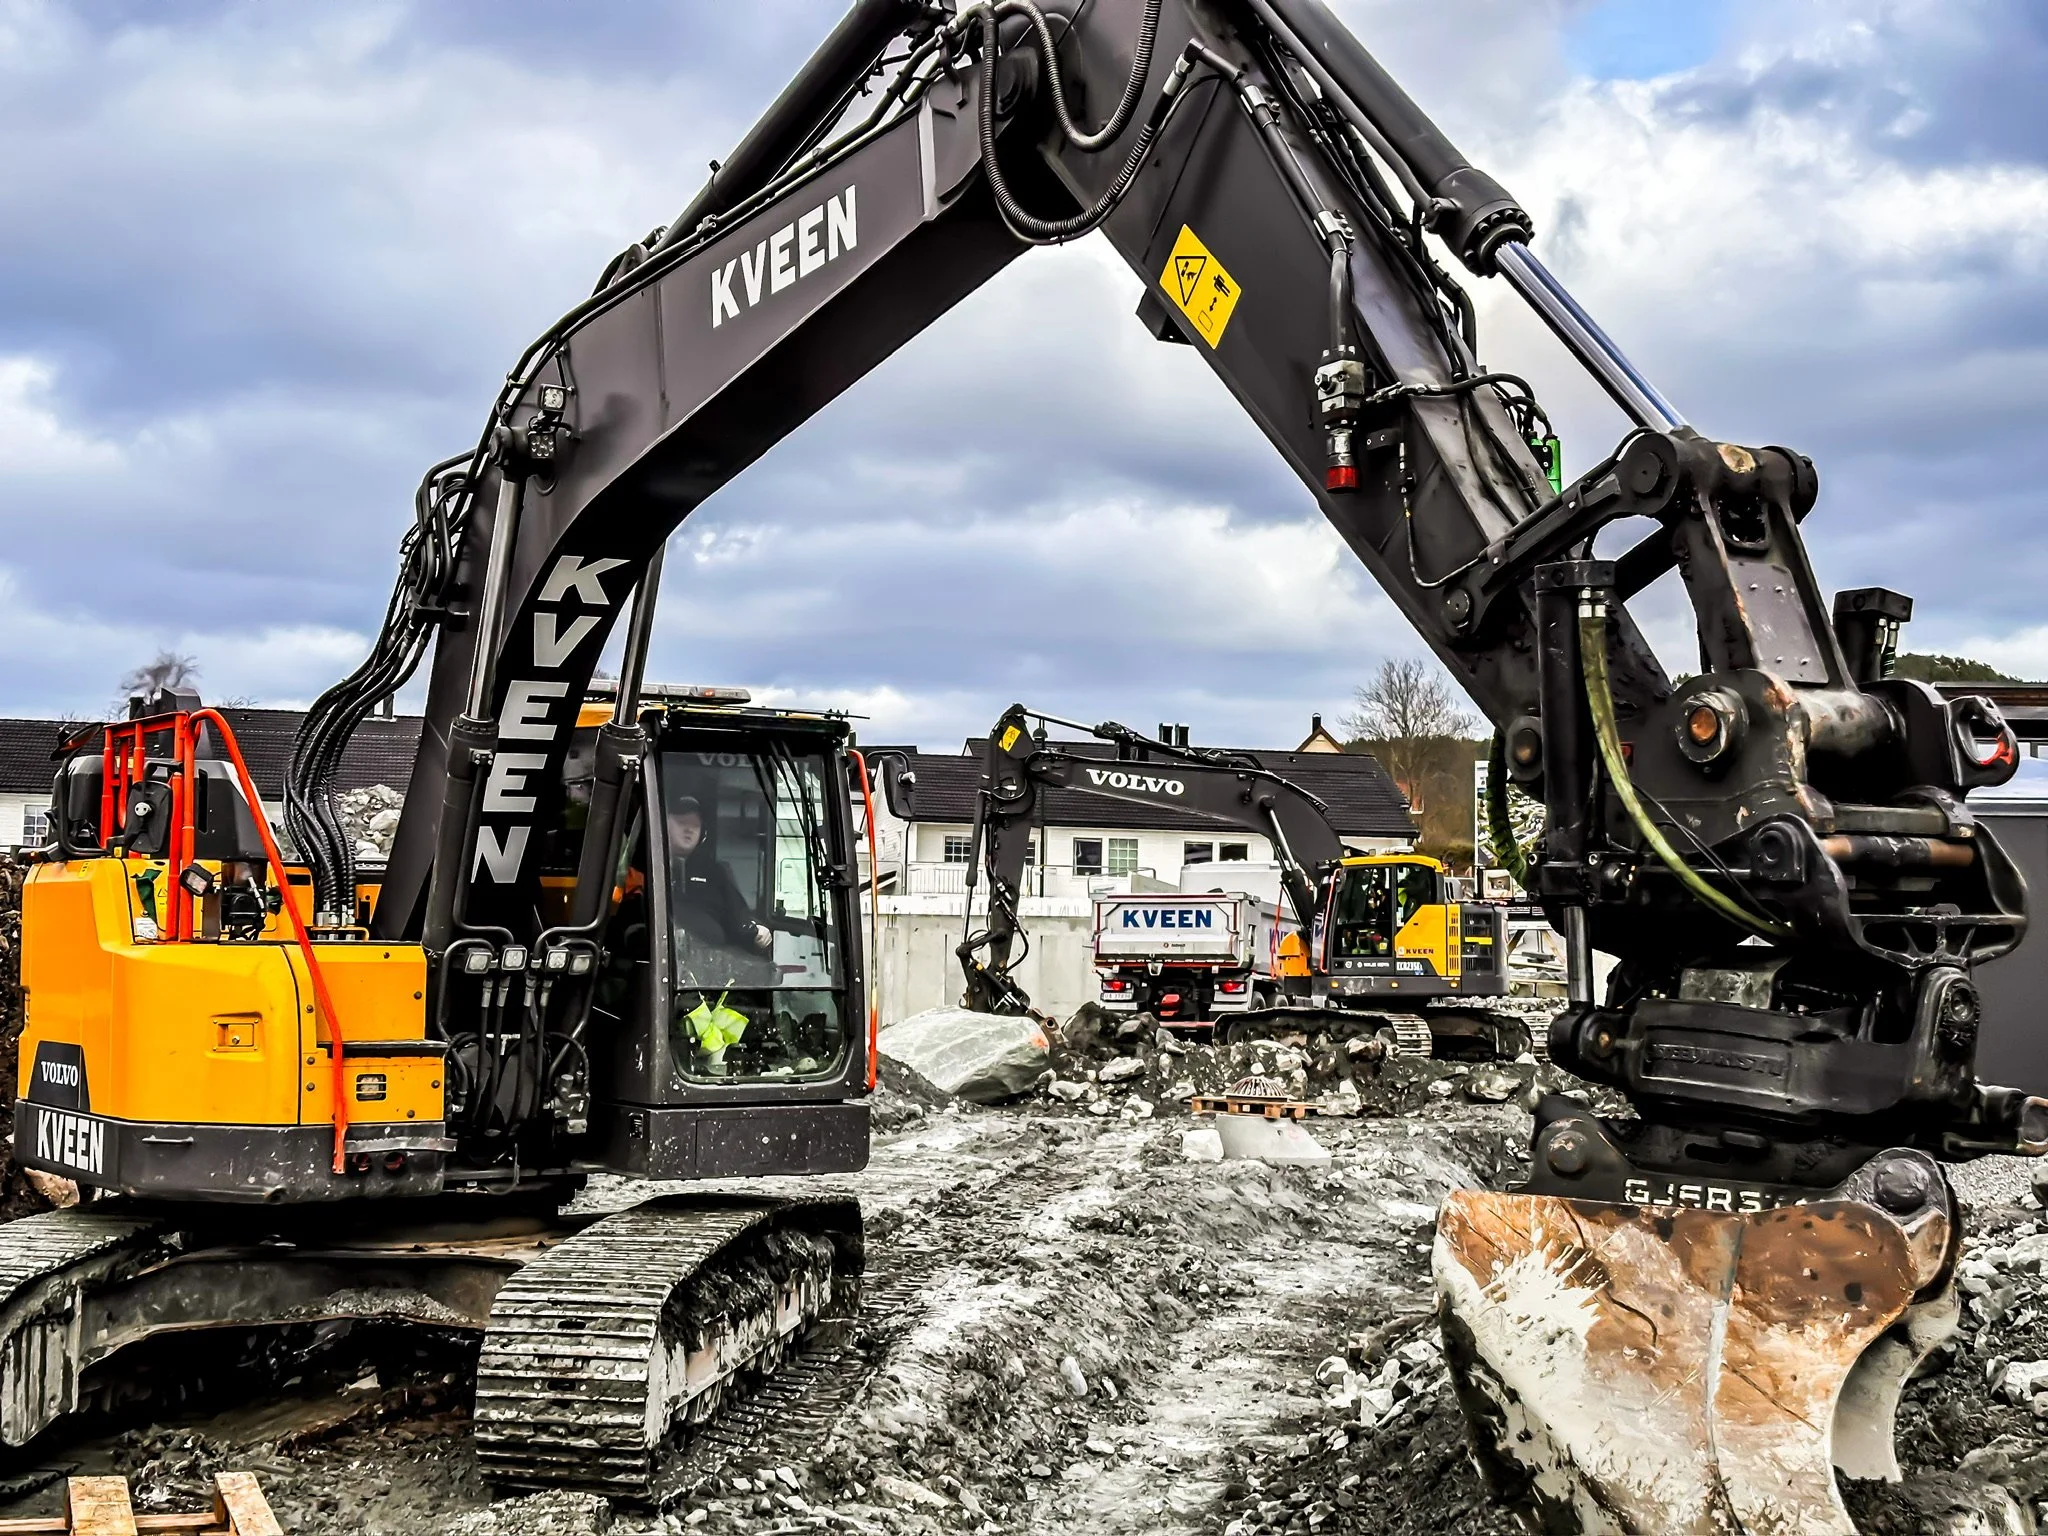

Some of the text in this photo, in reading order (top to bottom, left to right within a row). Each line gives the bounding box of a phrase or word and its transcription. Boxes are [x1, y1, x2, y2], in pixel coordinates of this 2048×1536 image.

[711, 184, 858, 329] KVEEN
[470, 555, 631, 883] KVEEN
[1085, 768, 1185, 796] VOLVO
[1122, 909, 1212, 929] KVEEN
[40, 1061, 79, 1087] VOLVO
[37, 1109, 105, 1175] KVEEN
